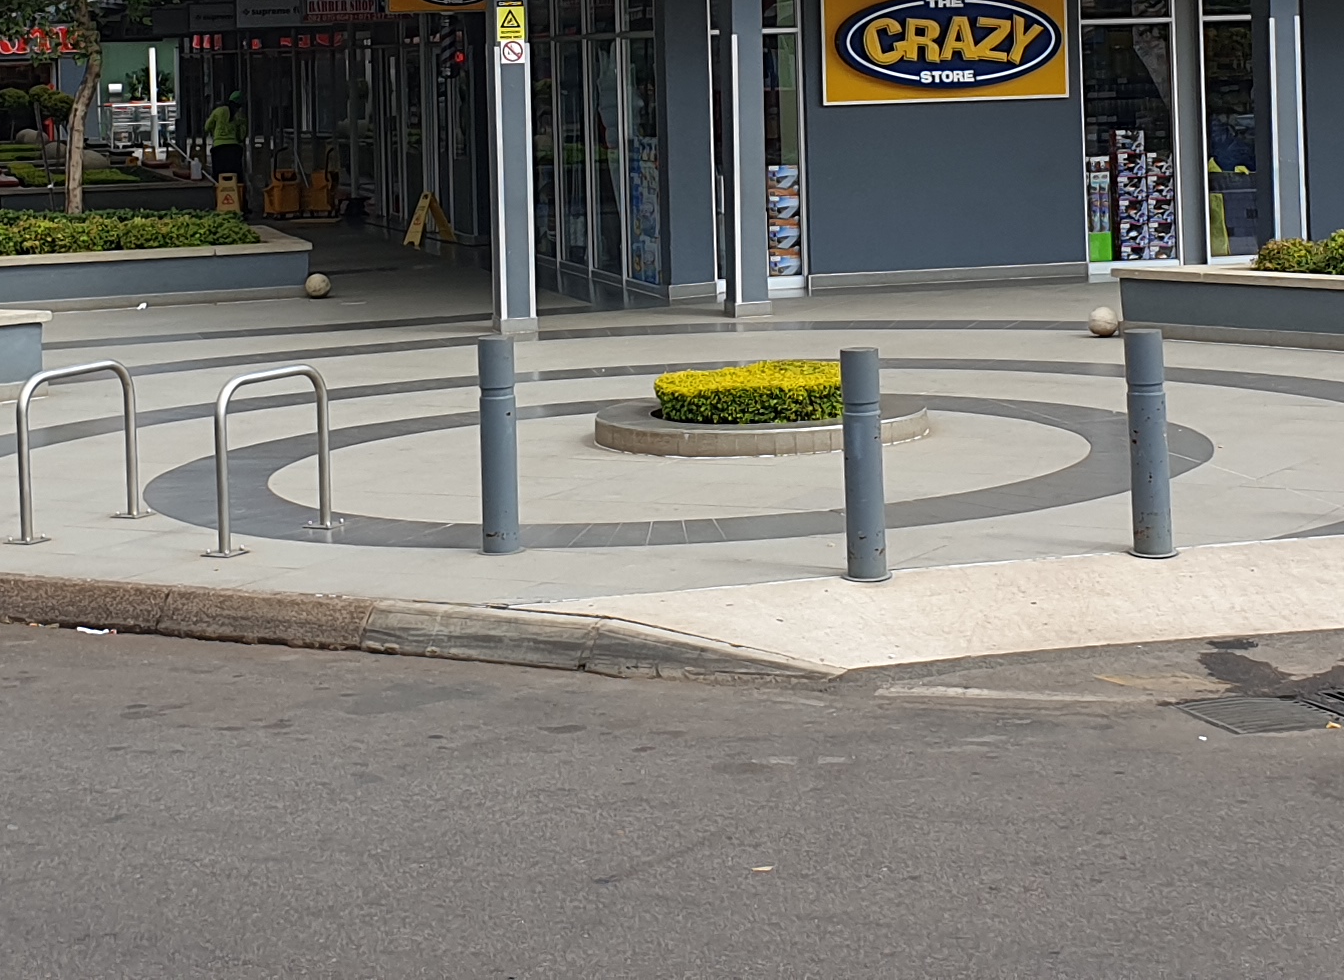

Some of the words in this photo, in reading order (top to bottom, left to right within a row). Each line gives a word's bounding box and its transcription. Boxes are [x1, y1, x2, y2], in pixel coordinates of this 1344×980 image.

[349, 0, 374, 12] SHOP
[251, 8, 291, 17] supreme
[863, 13, 1044, 66] CRAZY
[920, 70, 975, 83] STORE
